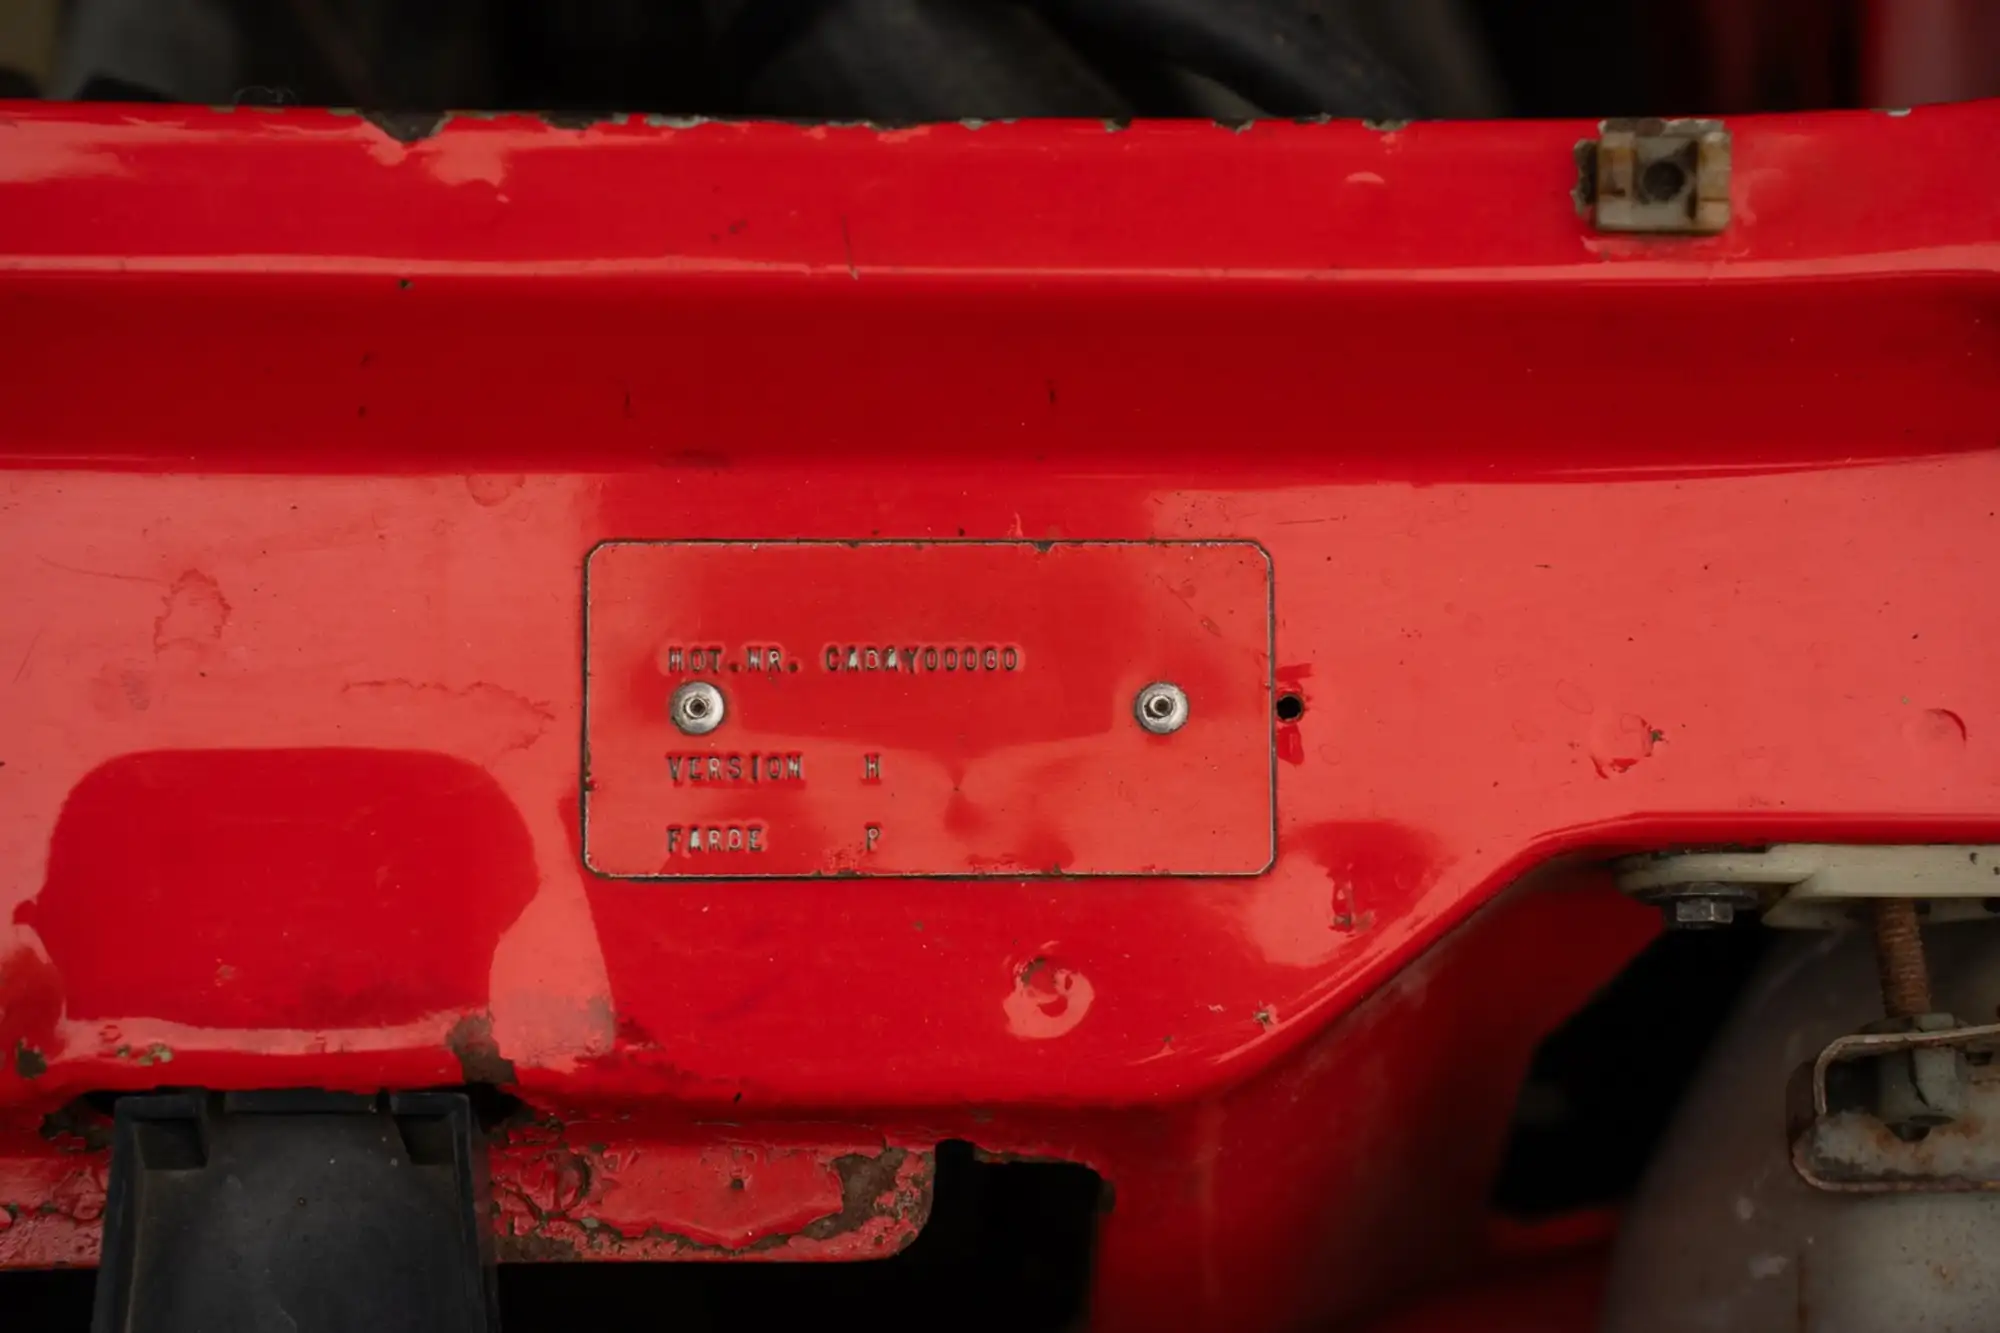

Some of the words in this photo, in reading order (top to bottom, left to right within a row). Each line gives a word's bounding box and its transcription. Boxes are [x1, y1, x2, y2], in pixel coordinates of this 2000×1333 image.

[667, 754, 803, 780] VERSION
[864, 754, 880, 780] H
[865, 826, 880, 852] P
